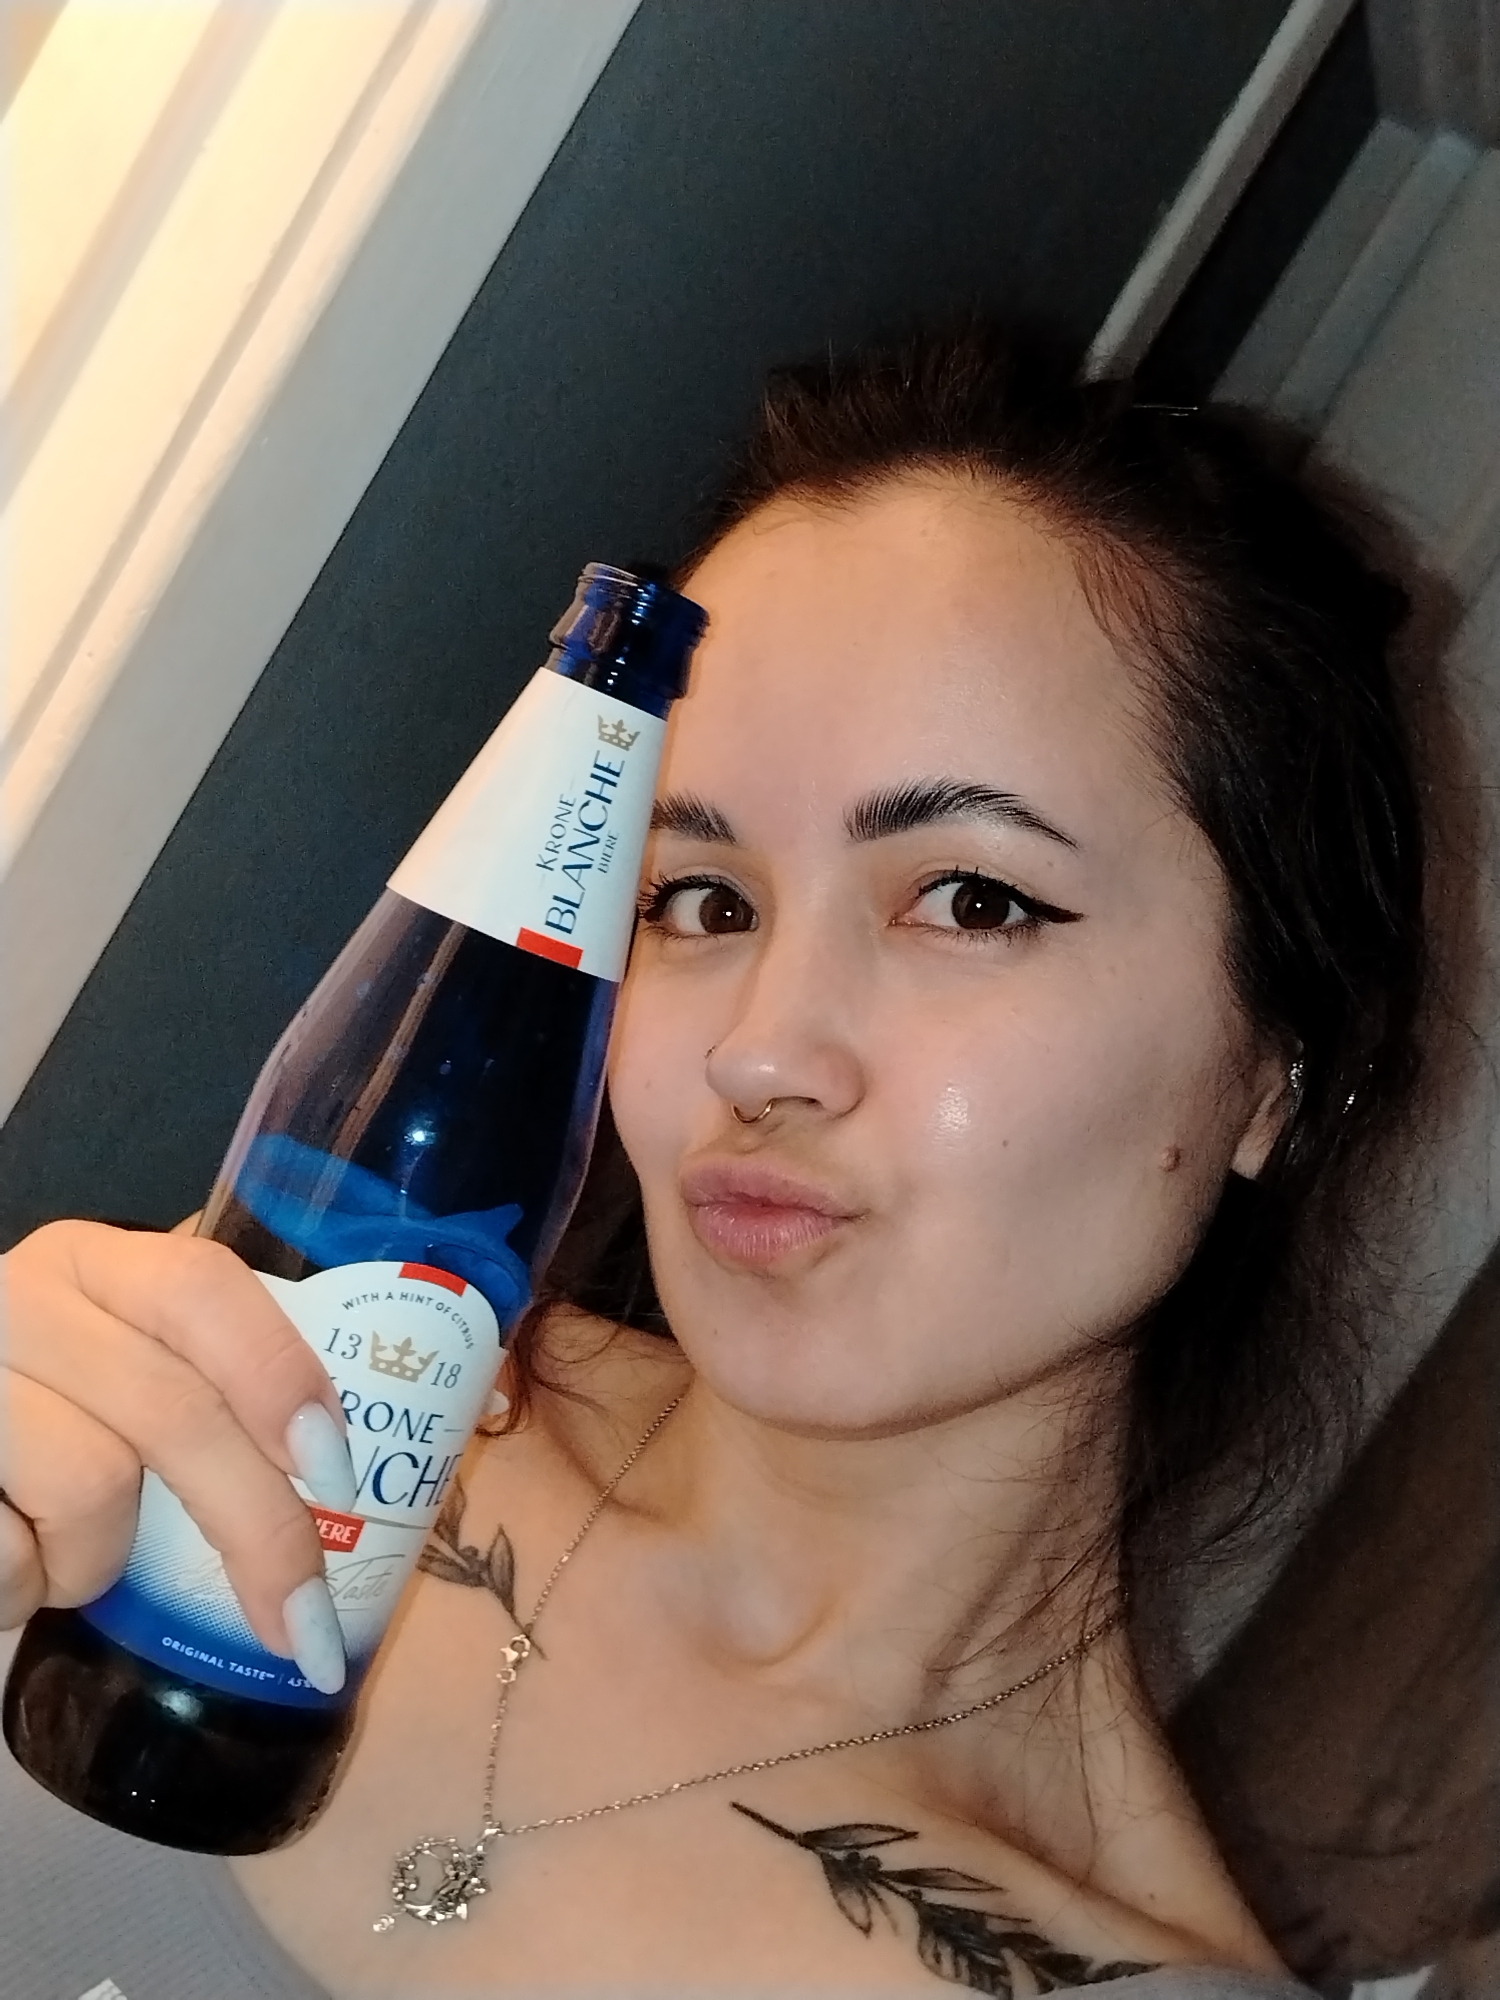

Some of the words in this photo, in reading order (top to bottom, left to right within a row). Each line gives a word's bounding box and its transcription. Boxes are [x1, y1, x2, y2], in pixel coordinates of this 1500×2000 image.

[535, 793, 577, 872] KRONE
[544, 749, 626, 935] BLANCHE
[597, 830, 621, 874] BIERE
[341, 1291, 380, 1311] WITH
[385, 1291, 395, 1301] A
[399, 1291, 435, 1306] HINT
[435, 1301, 453, 1314] OF
[451, 1312, 475, 1350] CITRUS
[323, 1327, 363, 1360] 13
[430, 1361, 463, 1389] 18
[330, 1376, 445, 1444] RONE
[316, 1517, 357, 1544] ERE
[161, 1636, 225, 1669] ORIGINAL
